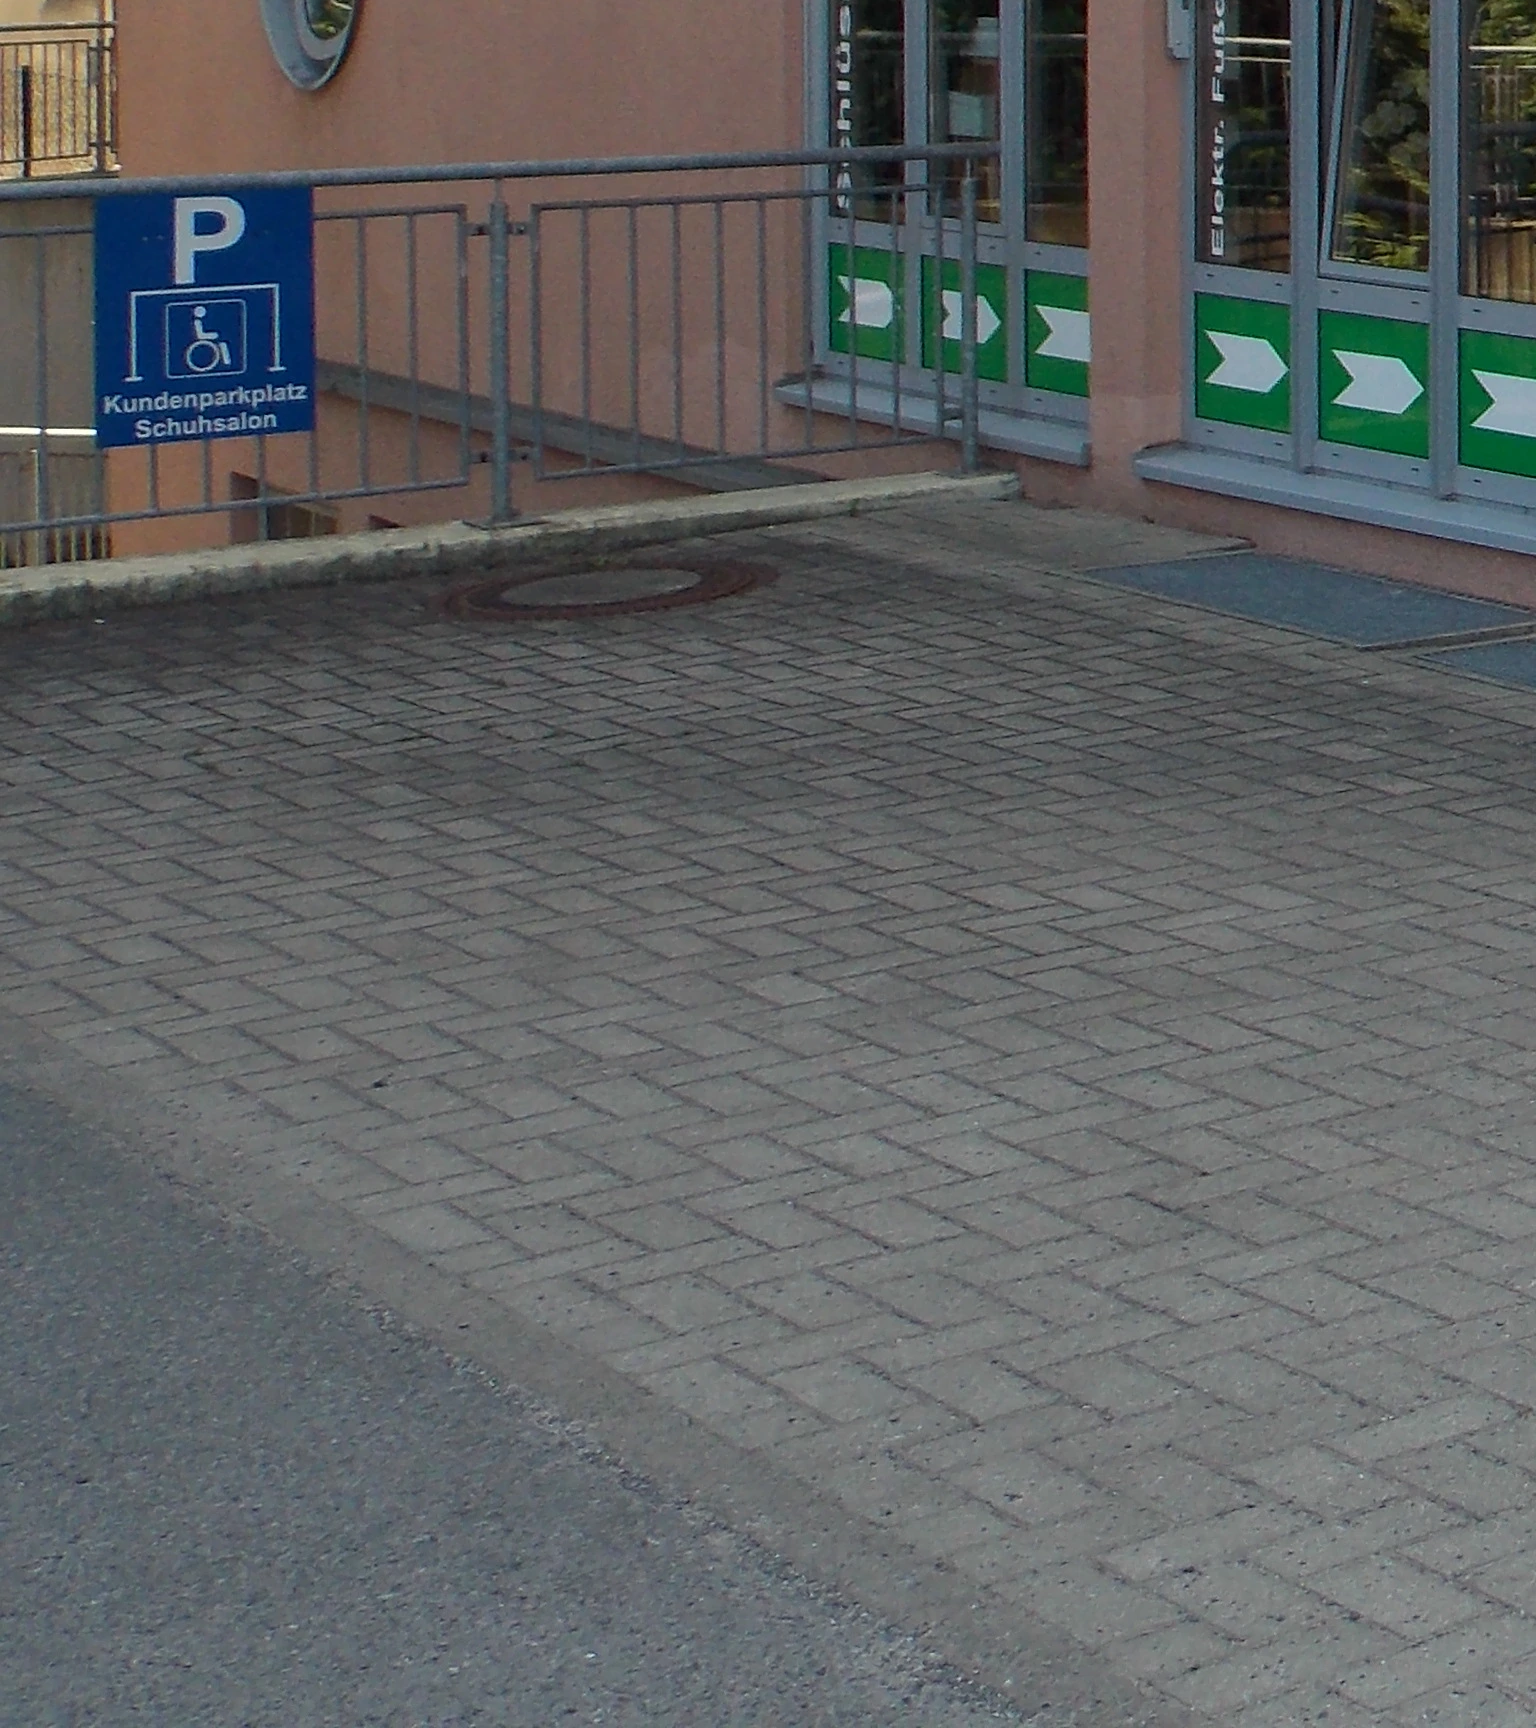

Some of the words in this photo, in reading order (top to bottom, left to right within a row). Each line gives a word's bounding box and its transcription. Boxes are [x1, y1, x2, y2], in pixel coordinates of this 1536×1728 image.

[1209, 119, 1228, 258] Elektr.
[171, 195, 247, 286] P
[102, 382, 308, 416] Kundenparkplatz
[134, 410, 279, 439] Schuhsalon
